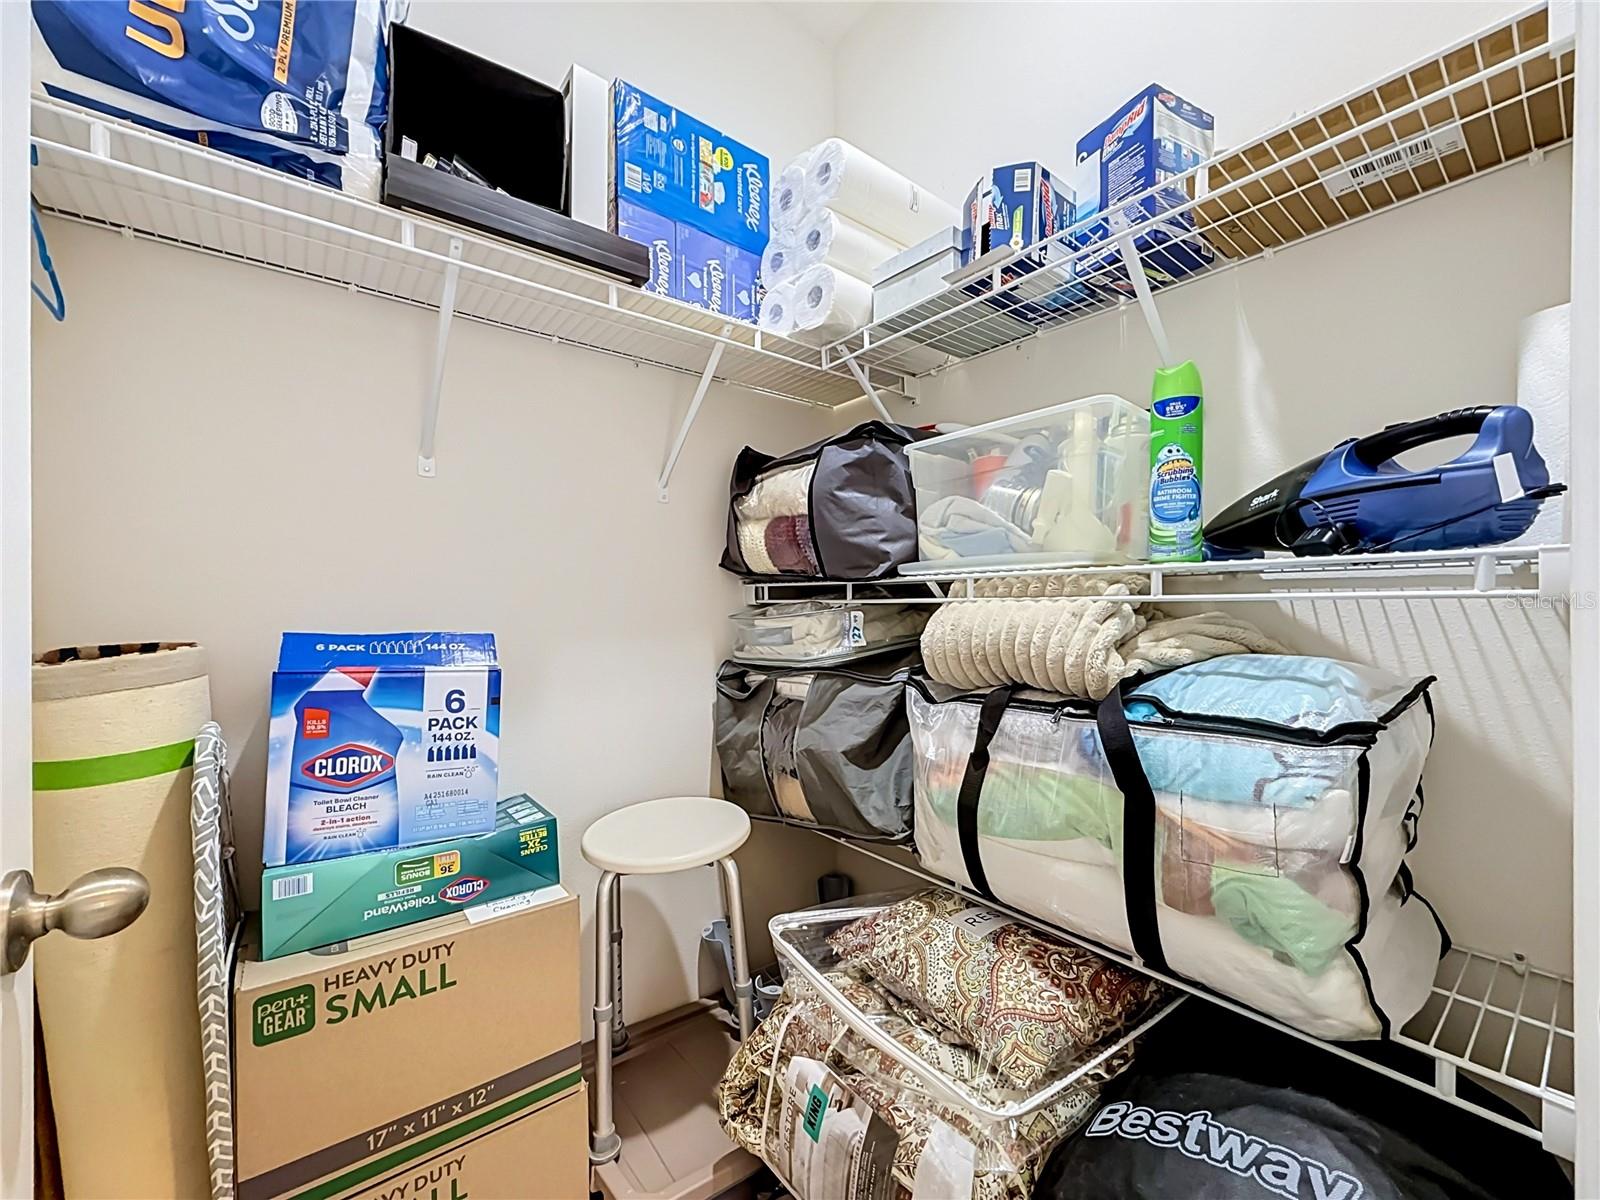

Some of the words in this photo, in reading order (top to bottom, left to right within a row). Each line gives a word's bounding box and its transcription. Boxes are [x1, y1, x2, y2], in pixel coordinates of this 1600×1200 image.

[281, 2, 294, 44] PREMIUM
[742, 163, 764, 232] Kleenex
[653, 240, 673, 296] Kleenex
[706, 259, 725, 313] Kleenex
[1156, 467, 1194, 480] Scrubbing
[1159, 475, 1191, 485] Bubbles
[1157, 488, 1192, 496] BATHROOM
[1250, 489, 1280, 507] Shark
[316, 643, 325, 651] 6
[328, 643, 366, 652] PACK
[426, 643, 447, 651] 144
[444, 689, 466, 714] 6
[428, 715, 478, 732] PACK
[431, 733, 452, 743] 144
[454, 731, 475, 742] OZ.
[314, 754, 383, 777] CLOROX
[326, 802, 367, 814] BLEACH
[321, 817, 344, 826] 2-in-1
[520, 831, 547, 843] BETTER
[527, 838, 541, 849] 2X
[520, 844, 548, 857] CLEANS
[400, 869, 431, 882] BONUS
[440, 864, 455, 875] 36
[385, 887, 415, 899] REFILLS
[446, 879, 484, 898] CLOROX
[364, 894, 437, 920] ToiletWand
[324, 957, 398, 993] HEAVY
[402, 941, 456, 970] DUTY
[325, 963, 458, 1025] SMALL
[257, 993, 309, 1024] pen+
[262, 1007, 307, 1037] GEAR
[366, 1124, 398, 1152] 17"
[402, 1122, 416, 1137] x
[421, 1105, 447, 1129] 11"
[451, 1104, 463, 1116] x
[467, 1084, 496, 1109] 12"
[782, 1086, 798, 1153] RESTORE
[807, 1095, 823, 1130] KING
[1086, 1101, 1364, 1200] Bestway
[414, 1155, 466, 1192] DUTY
